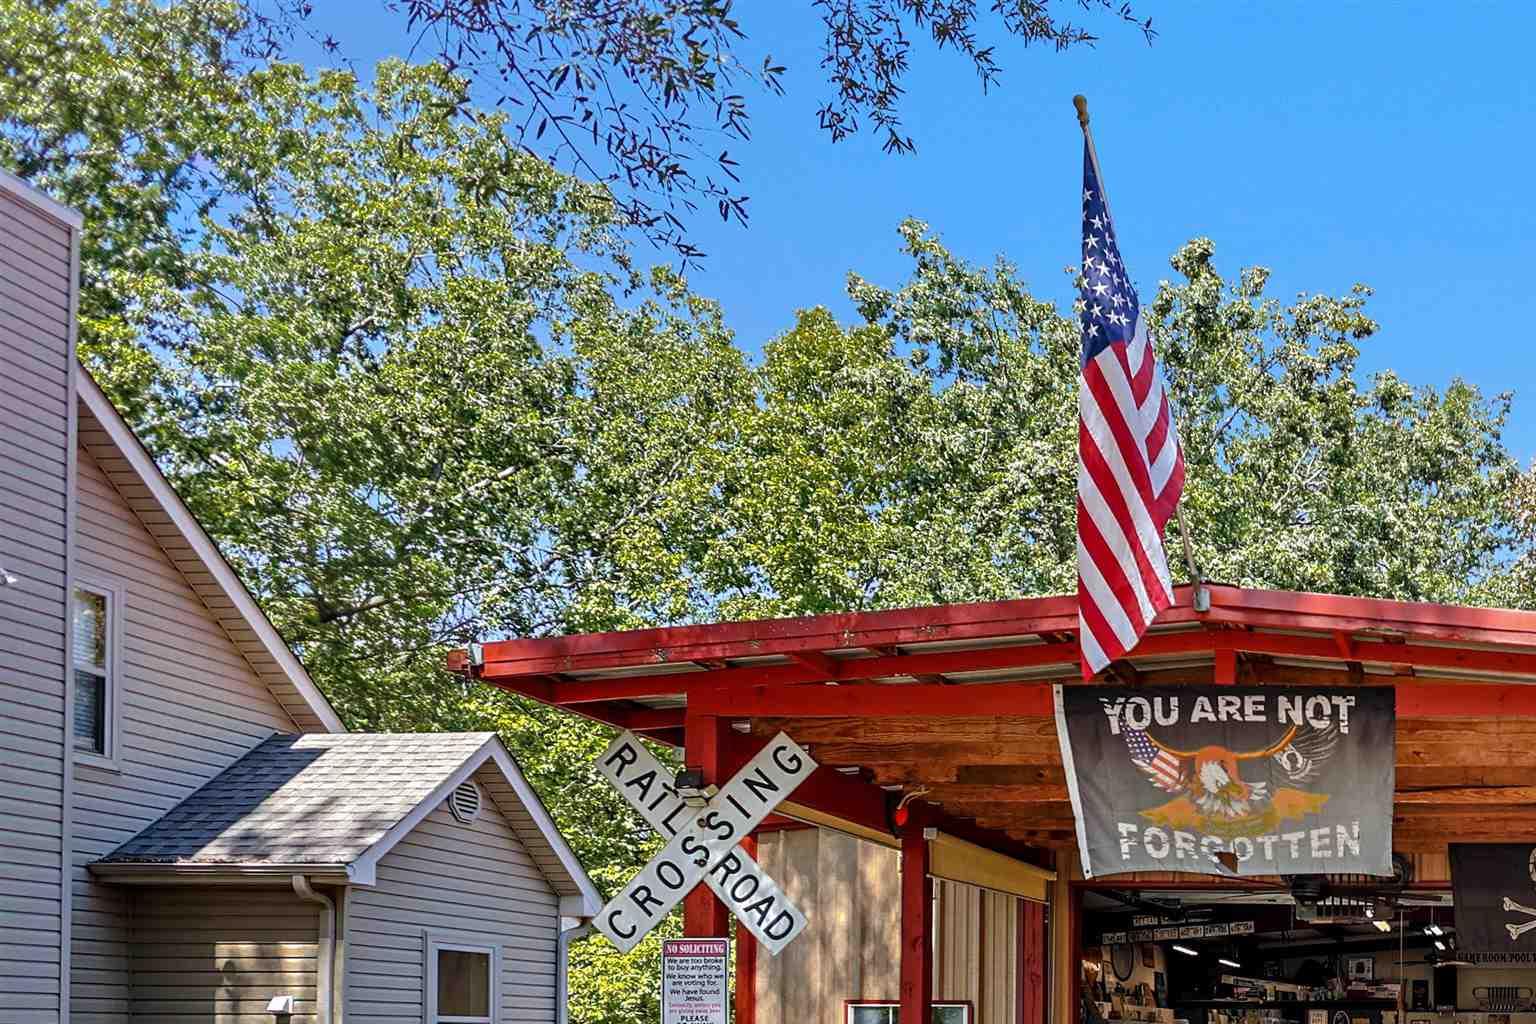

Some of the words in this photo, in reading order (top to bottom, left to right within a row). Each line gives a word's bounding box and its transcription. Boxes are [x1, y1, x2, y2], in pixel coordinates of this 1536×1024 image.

[1099, 695, 1180, 734] YOU
[1190, 695, 1270, 723] ARE
[1277, 695, 1356, 734] NOT
[604, 742, 687, 837] RAIL
[710, 851, 795, 942] ROAD
[607, 744, 804, 940] CROSSING
[1117, 820, 1361, 860] FORGOTTEN
[666, 943, 679, 953] NO
[679, 943, 725, 954] SOLICITING
